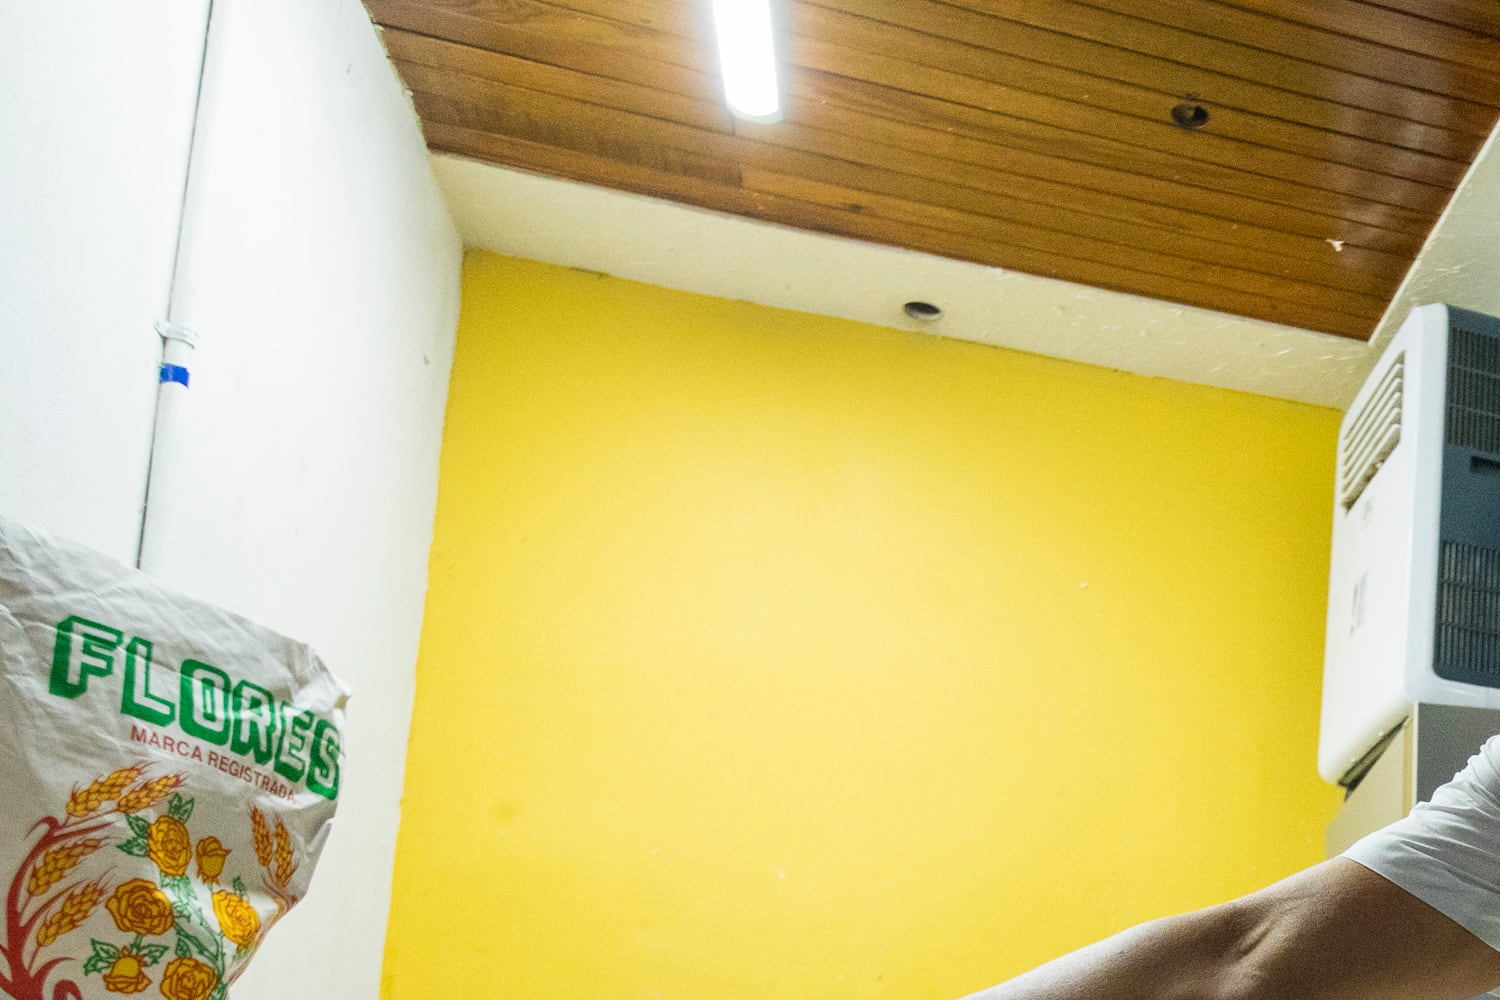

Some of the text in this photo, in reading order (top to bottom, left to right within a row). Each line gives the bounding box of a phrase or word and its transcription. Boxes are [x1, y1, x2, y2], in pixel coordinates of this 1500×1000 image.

[49, 614, 341, 801] FLORES
[130, 725, 296, 802] MARCA REGISTRADA
